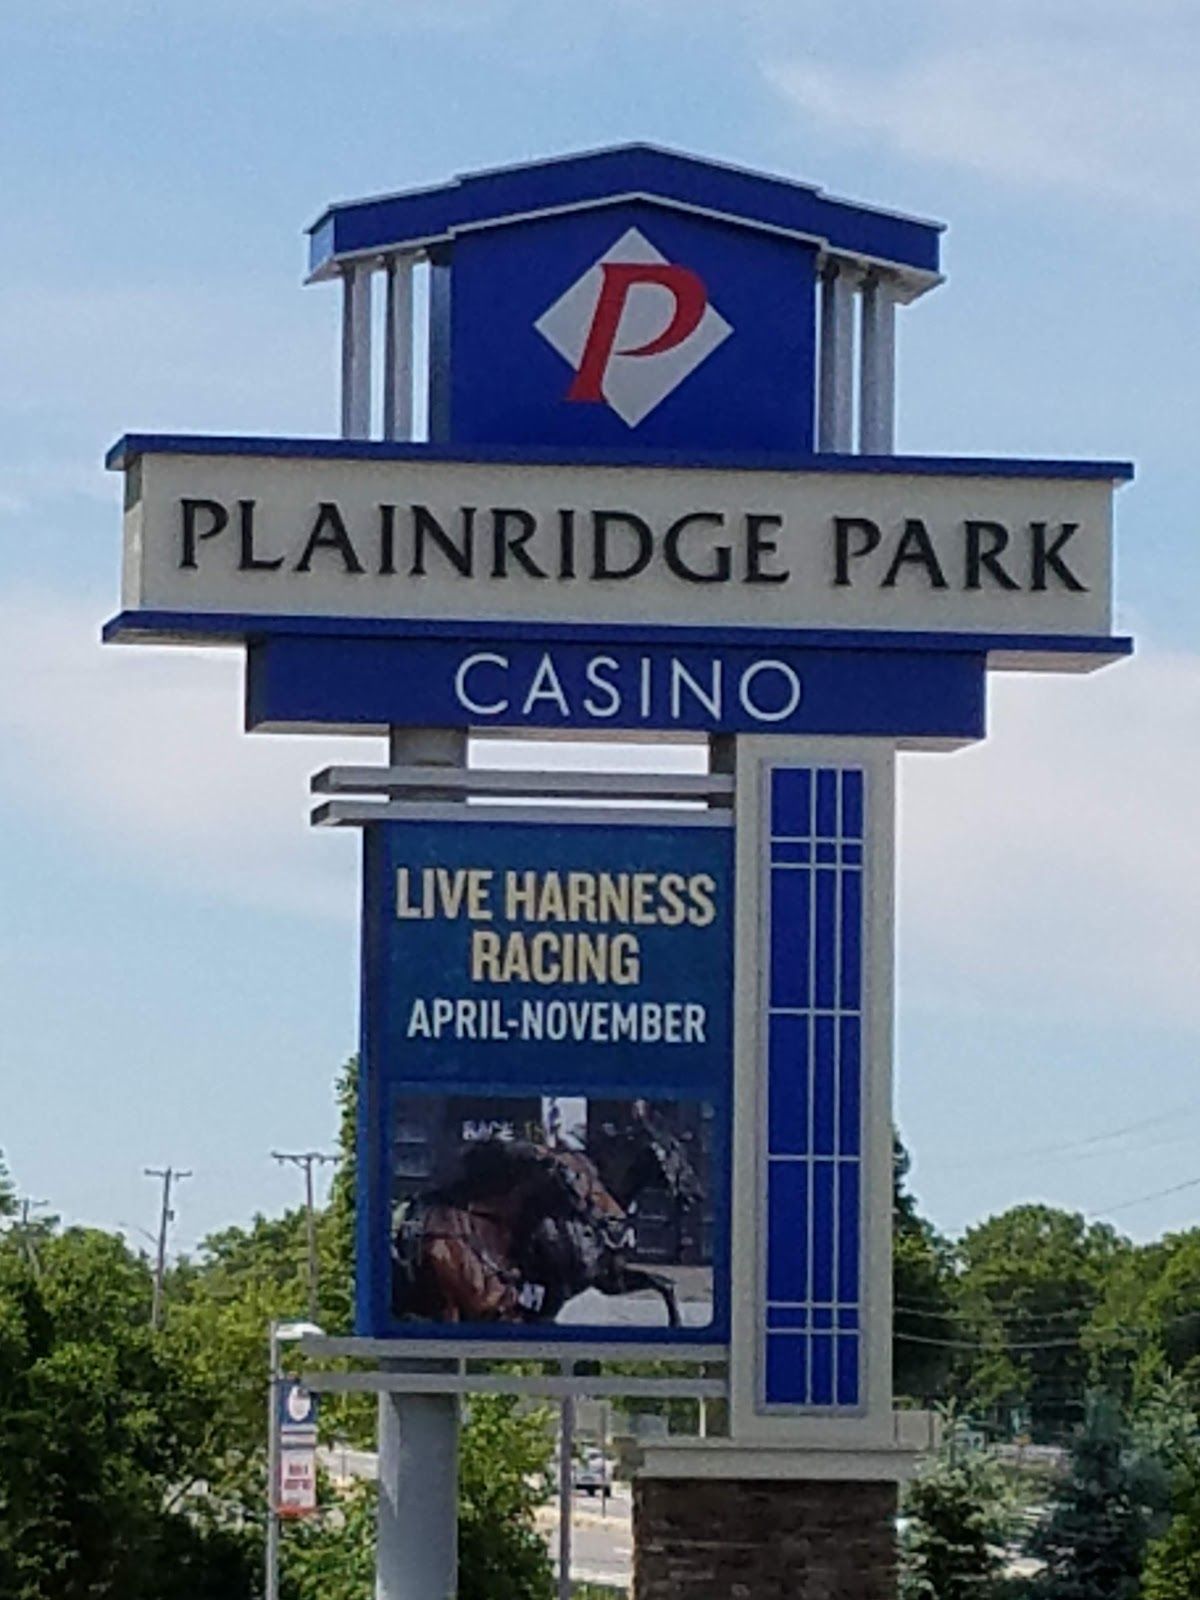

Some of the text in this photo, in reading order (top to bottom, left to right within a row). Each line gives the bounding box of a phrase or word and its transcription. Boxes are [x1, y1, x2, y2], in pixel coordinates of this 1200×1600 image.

[564, 262, 708, 404] P
[178, 497, 1090, 593] PLAINRIDGE PARK
[454, 652, 801, 722] CASINO
[396, 868, 717, 927] LIVE HARNESS
[471, 930, 641, 985] RACING
[407, 998, 706, 1043] APRIL-NOVEMBER
